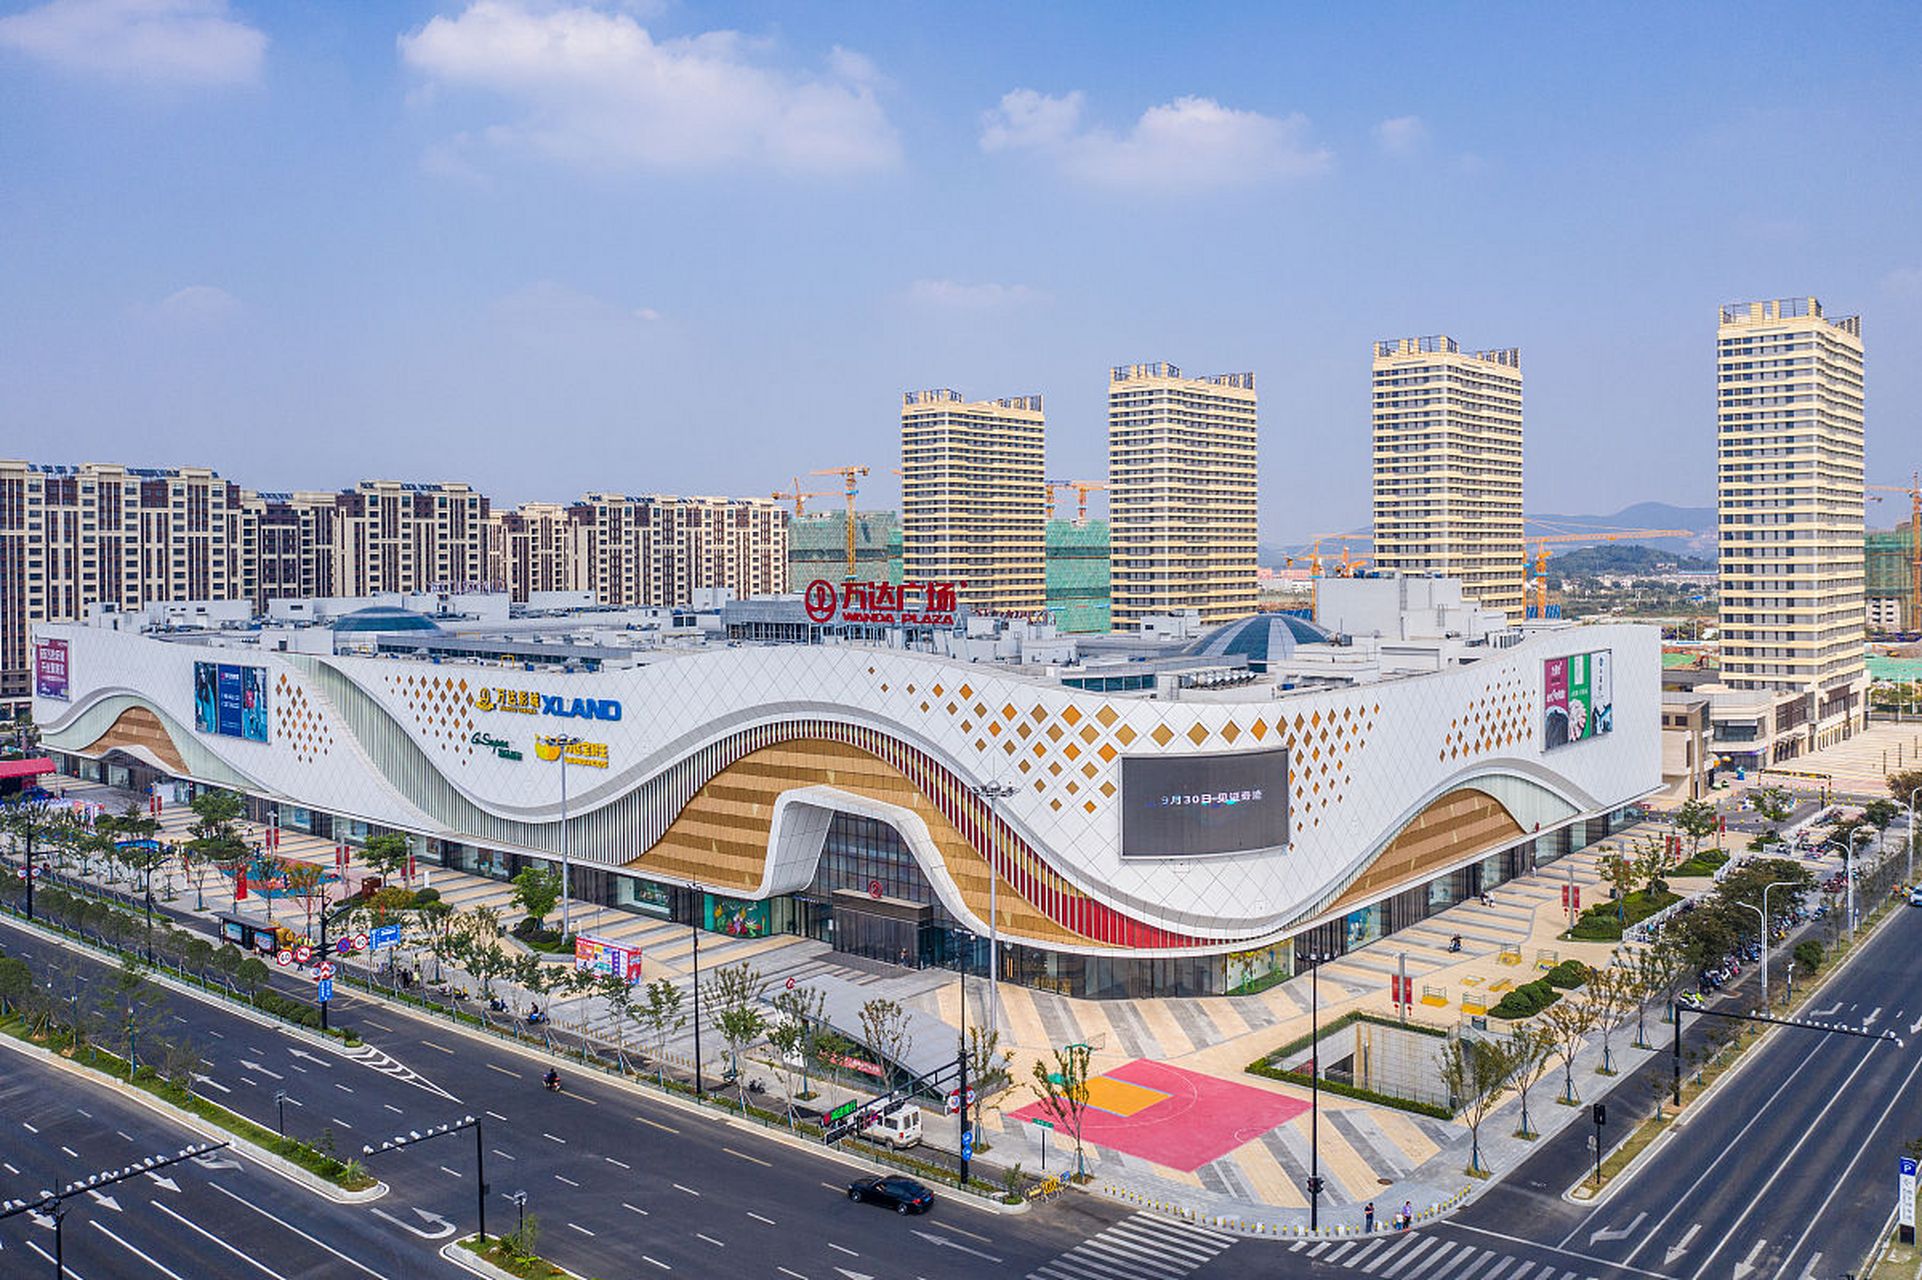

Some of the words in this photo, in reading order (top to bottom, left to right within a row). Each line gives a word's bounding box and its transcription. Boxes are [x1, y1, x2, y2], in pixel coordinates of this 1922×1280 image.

[841, 581, 956, 612] 万达广场
[842, 612, 895, 623] WANDA
[901, 613, 954, 625] PLAZA
[542, 694, 622, 721] XLAND
[1904, 1164, 1912, 1173] P
